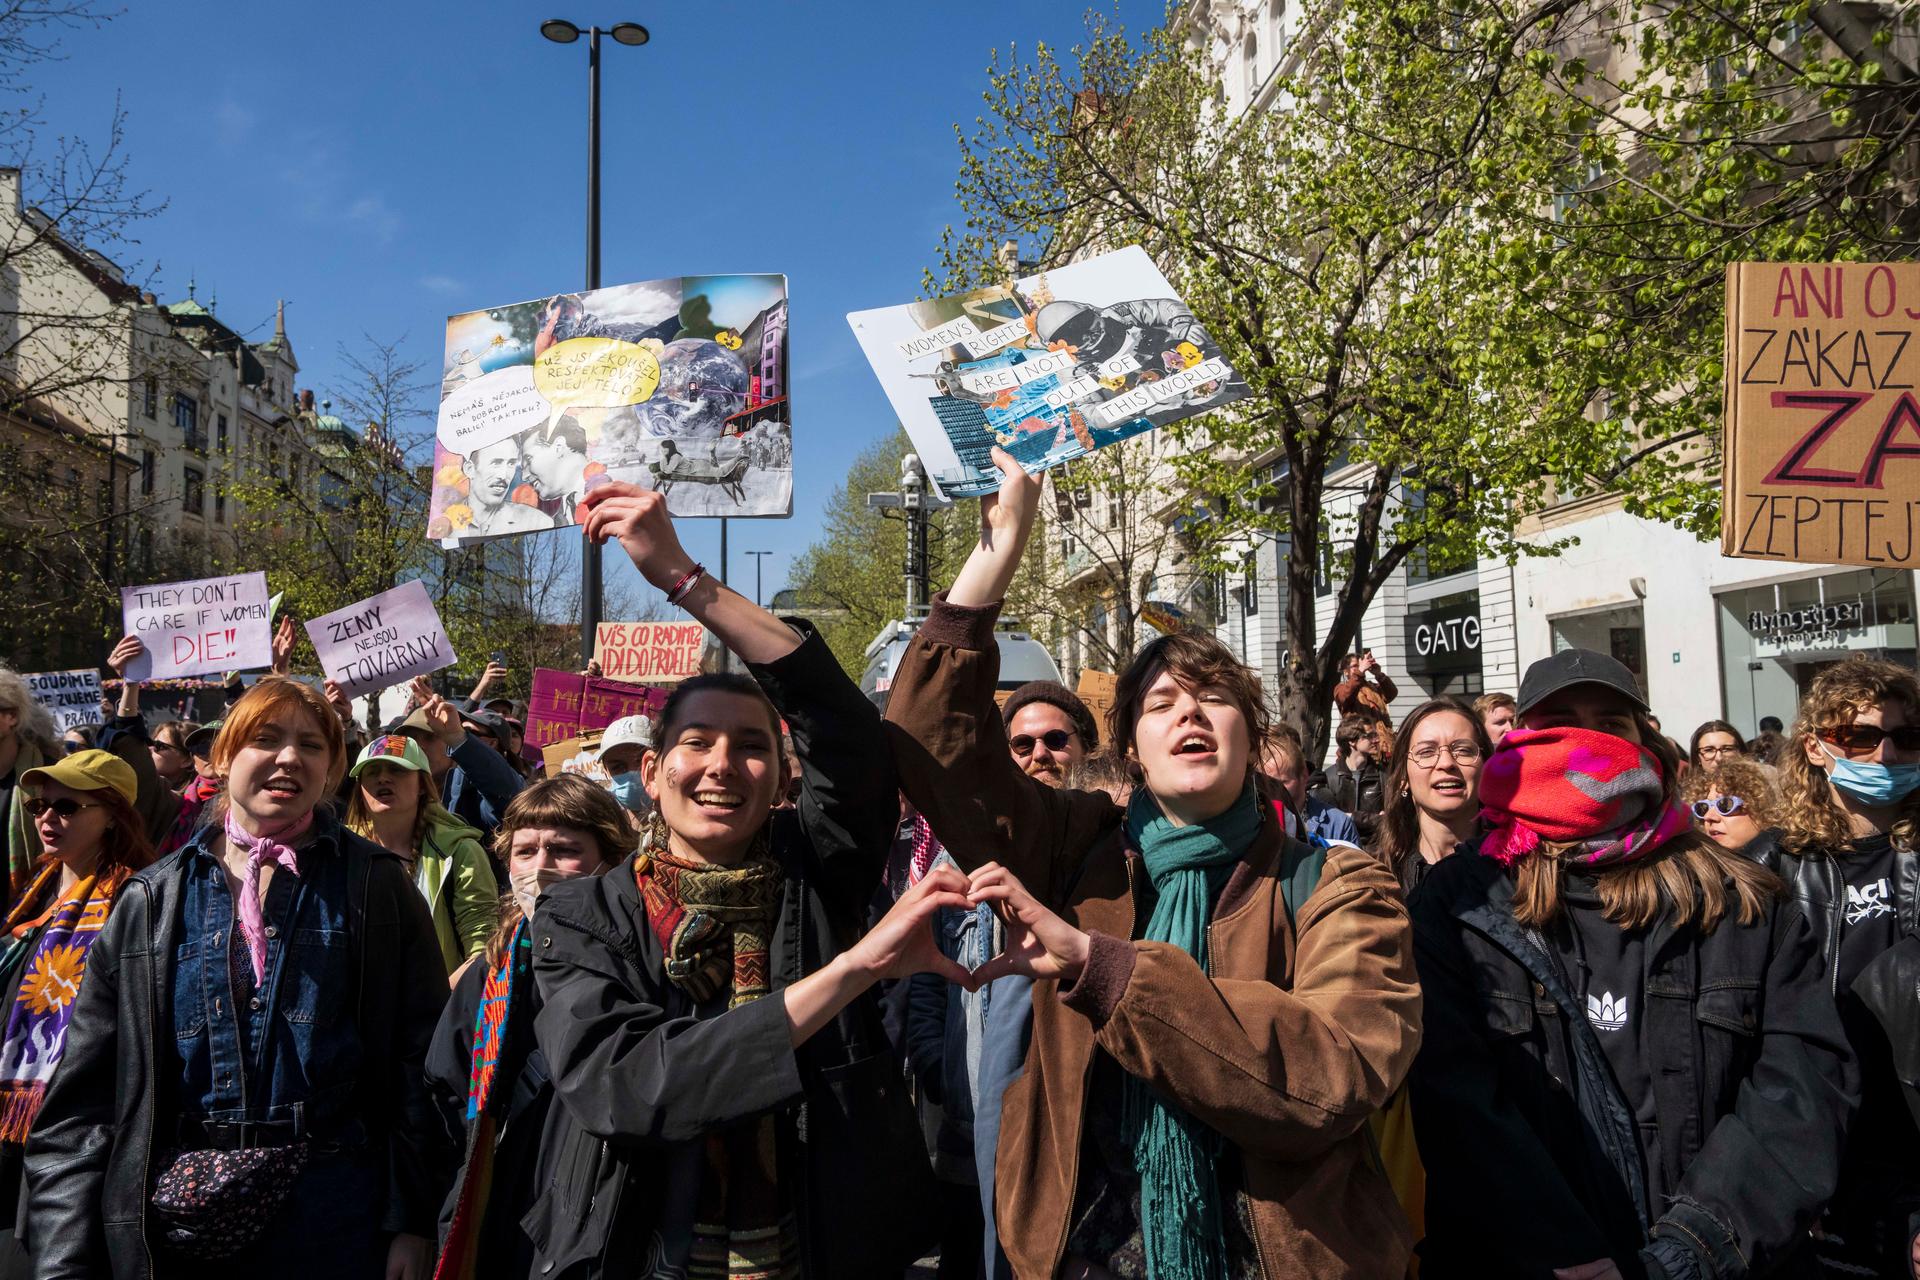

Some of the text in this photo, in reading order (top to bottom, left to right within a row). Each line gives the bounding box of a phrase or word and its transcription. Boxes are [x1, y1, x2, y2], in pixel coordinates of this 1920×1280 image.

[1773, 266, 1843, 319] ANI
[900, 321, 1027, 356] WOMEN'S RIGHTS
[547, 365, 643, 385] RESPEKTOVAT
[974, 353, 1065, 391] ARE NOT
[1741, 327, 1914, 390] ZÁKAZ
[1046, 356, 1133, 407] OUT OF
[1101, 362, 1222, 417] THIS WORLD
[471, 402, 507, 422] DOBROU
[1740, 494, 1920, 562] ZEPTEJ
[134, 580, 241, 610] THEY DON'T
[135, 604, 267, 631] CARE IF WOMEN
[327, 606, 383, 643] ŽENY
[1748, 602, 1864, 634] flying tiger
[173, 627, 237, 665] DIE!!
[355, 626, 398, 653] NEJSOU
[631, 626, 650, 647] CO
[337, 631, 440, 687] TOVÁRNY
